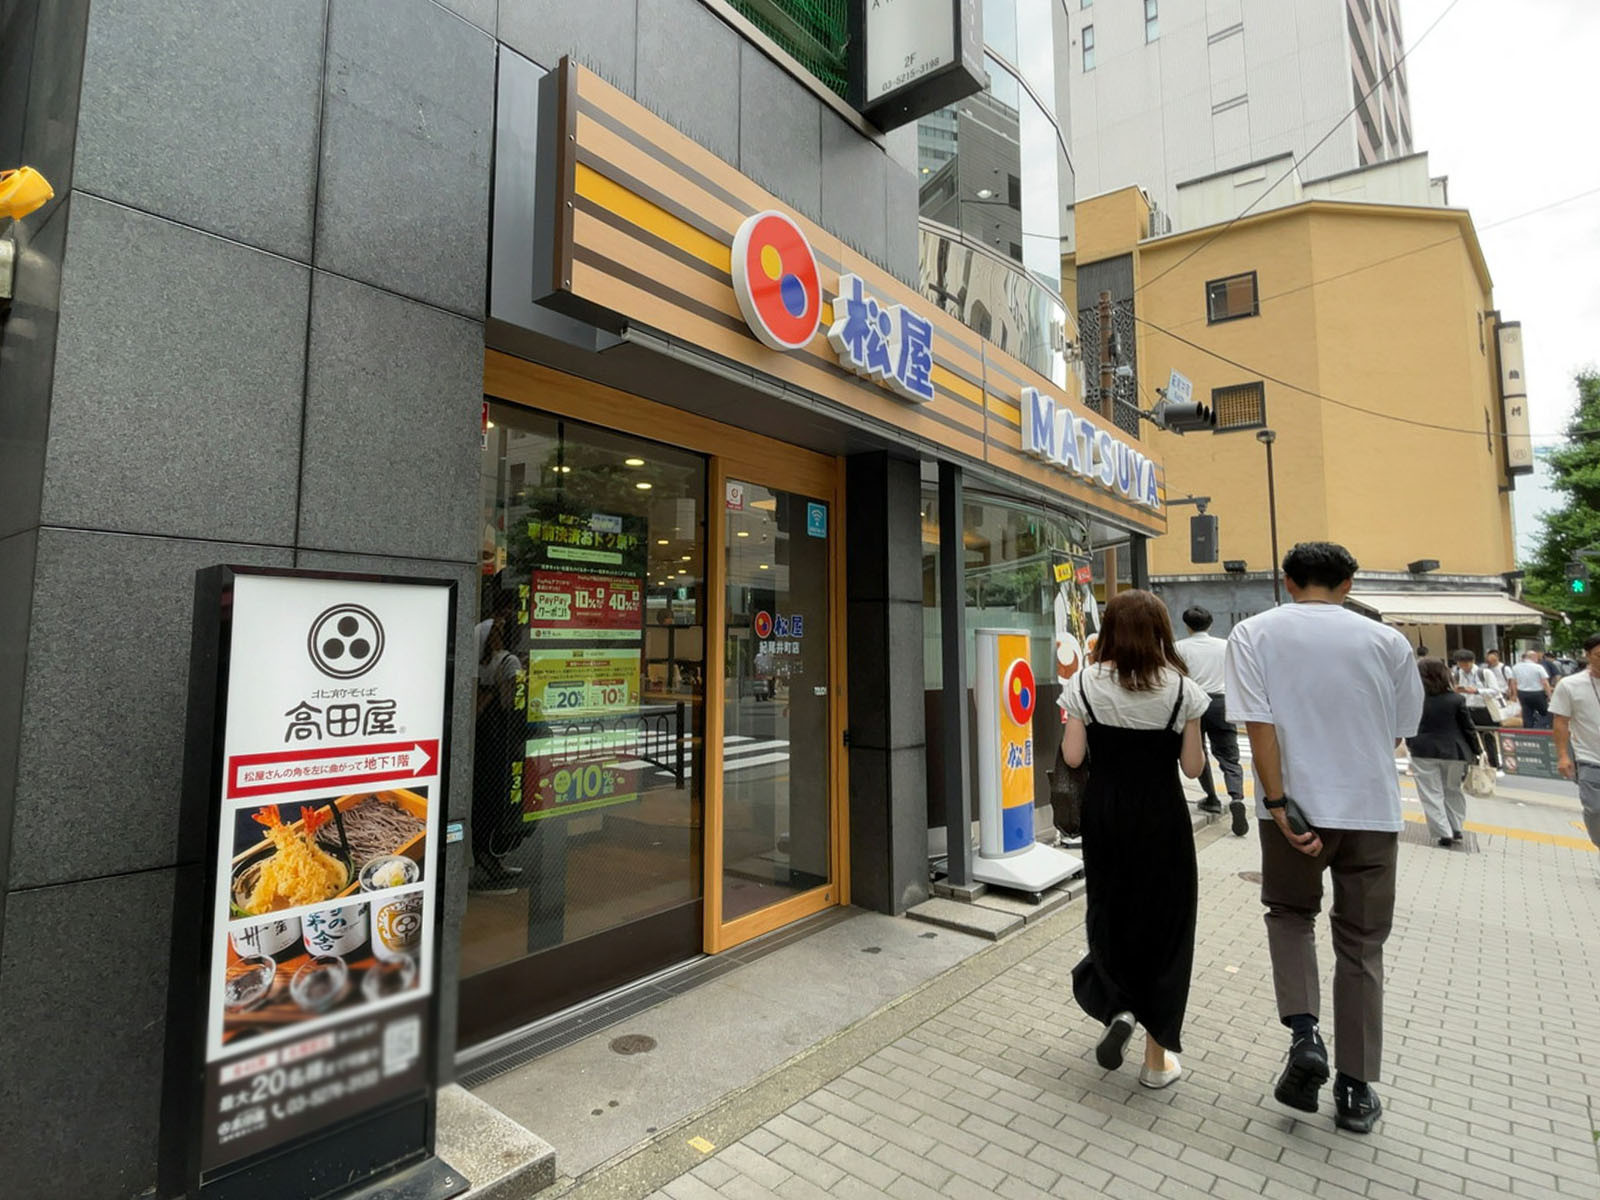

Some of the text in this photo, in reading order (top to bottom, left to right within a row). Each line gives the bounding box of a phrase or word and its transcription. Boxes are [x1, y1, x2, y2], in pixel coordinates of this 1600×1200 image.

[904, 52, 917, 68] 2F
[830, 273, 935, 402] 松屋
[1022, 386, 1161, 509] MATSUYA
[774, 613, 803, 638] 松屋
[311, 687, 379, 699] 北前そば
[284, 699, 397, 743] 高田屋
[1007, 740, 1033, 769] 松屋
